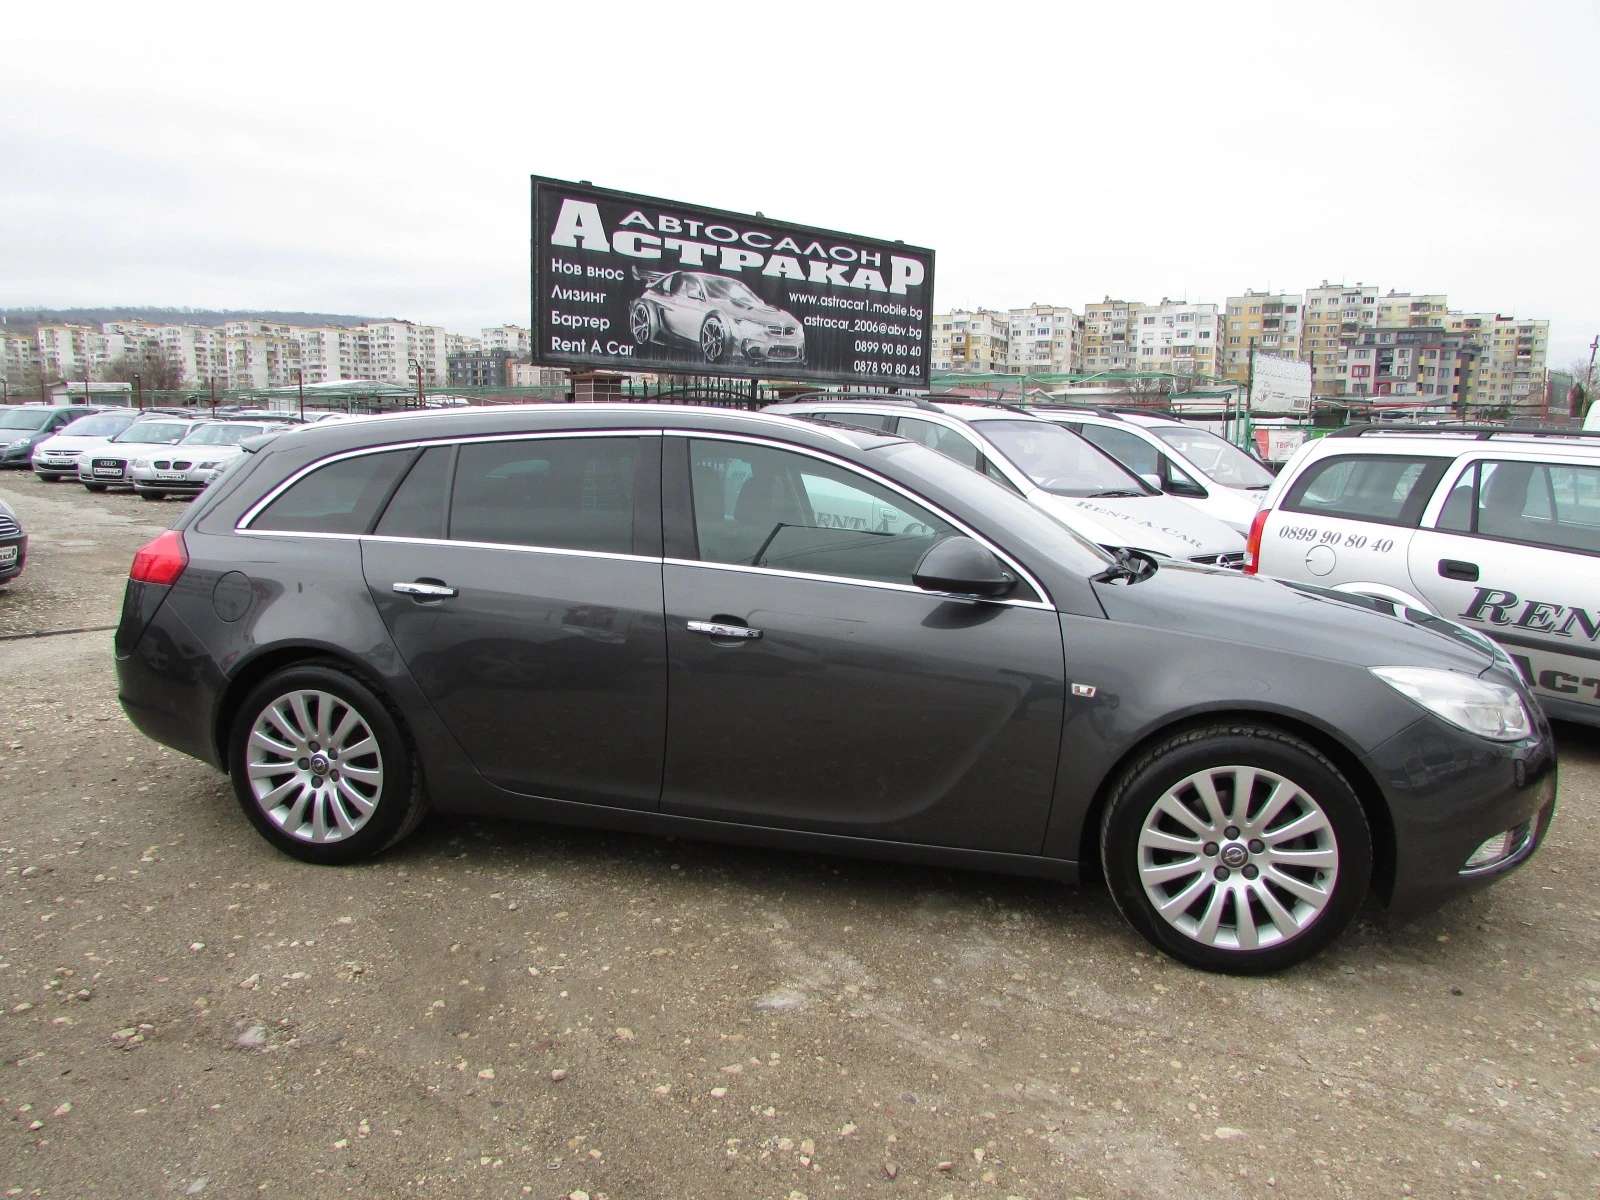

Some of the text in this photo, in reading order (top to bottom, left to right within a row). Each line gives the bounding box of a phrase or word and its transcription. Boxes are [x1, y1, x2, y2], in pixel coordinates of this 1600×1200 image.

[551, 199, 924, 296] АСТРАКАР
[619, 210, 881, 267] АВТОСАЛОН
[552, 258, 625, 281] Нов внос
[551, 284, 607, 304] Лизинг
[789, 292, 923, 320] www.astracar1.mobile.bg
[551, 310, 610, 332] Бартер
[804, 315, 922, 340] astracar_2006@abv.bg
[551, 336, 634, 356] Rent A Car
[854, 340, 921, 357] 0899 90 80 40
[853, 360, 920, 376] 0878 90 80 43
[1279, 525, 1394, 553] 0899 90 80 40
